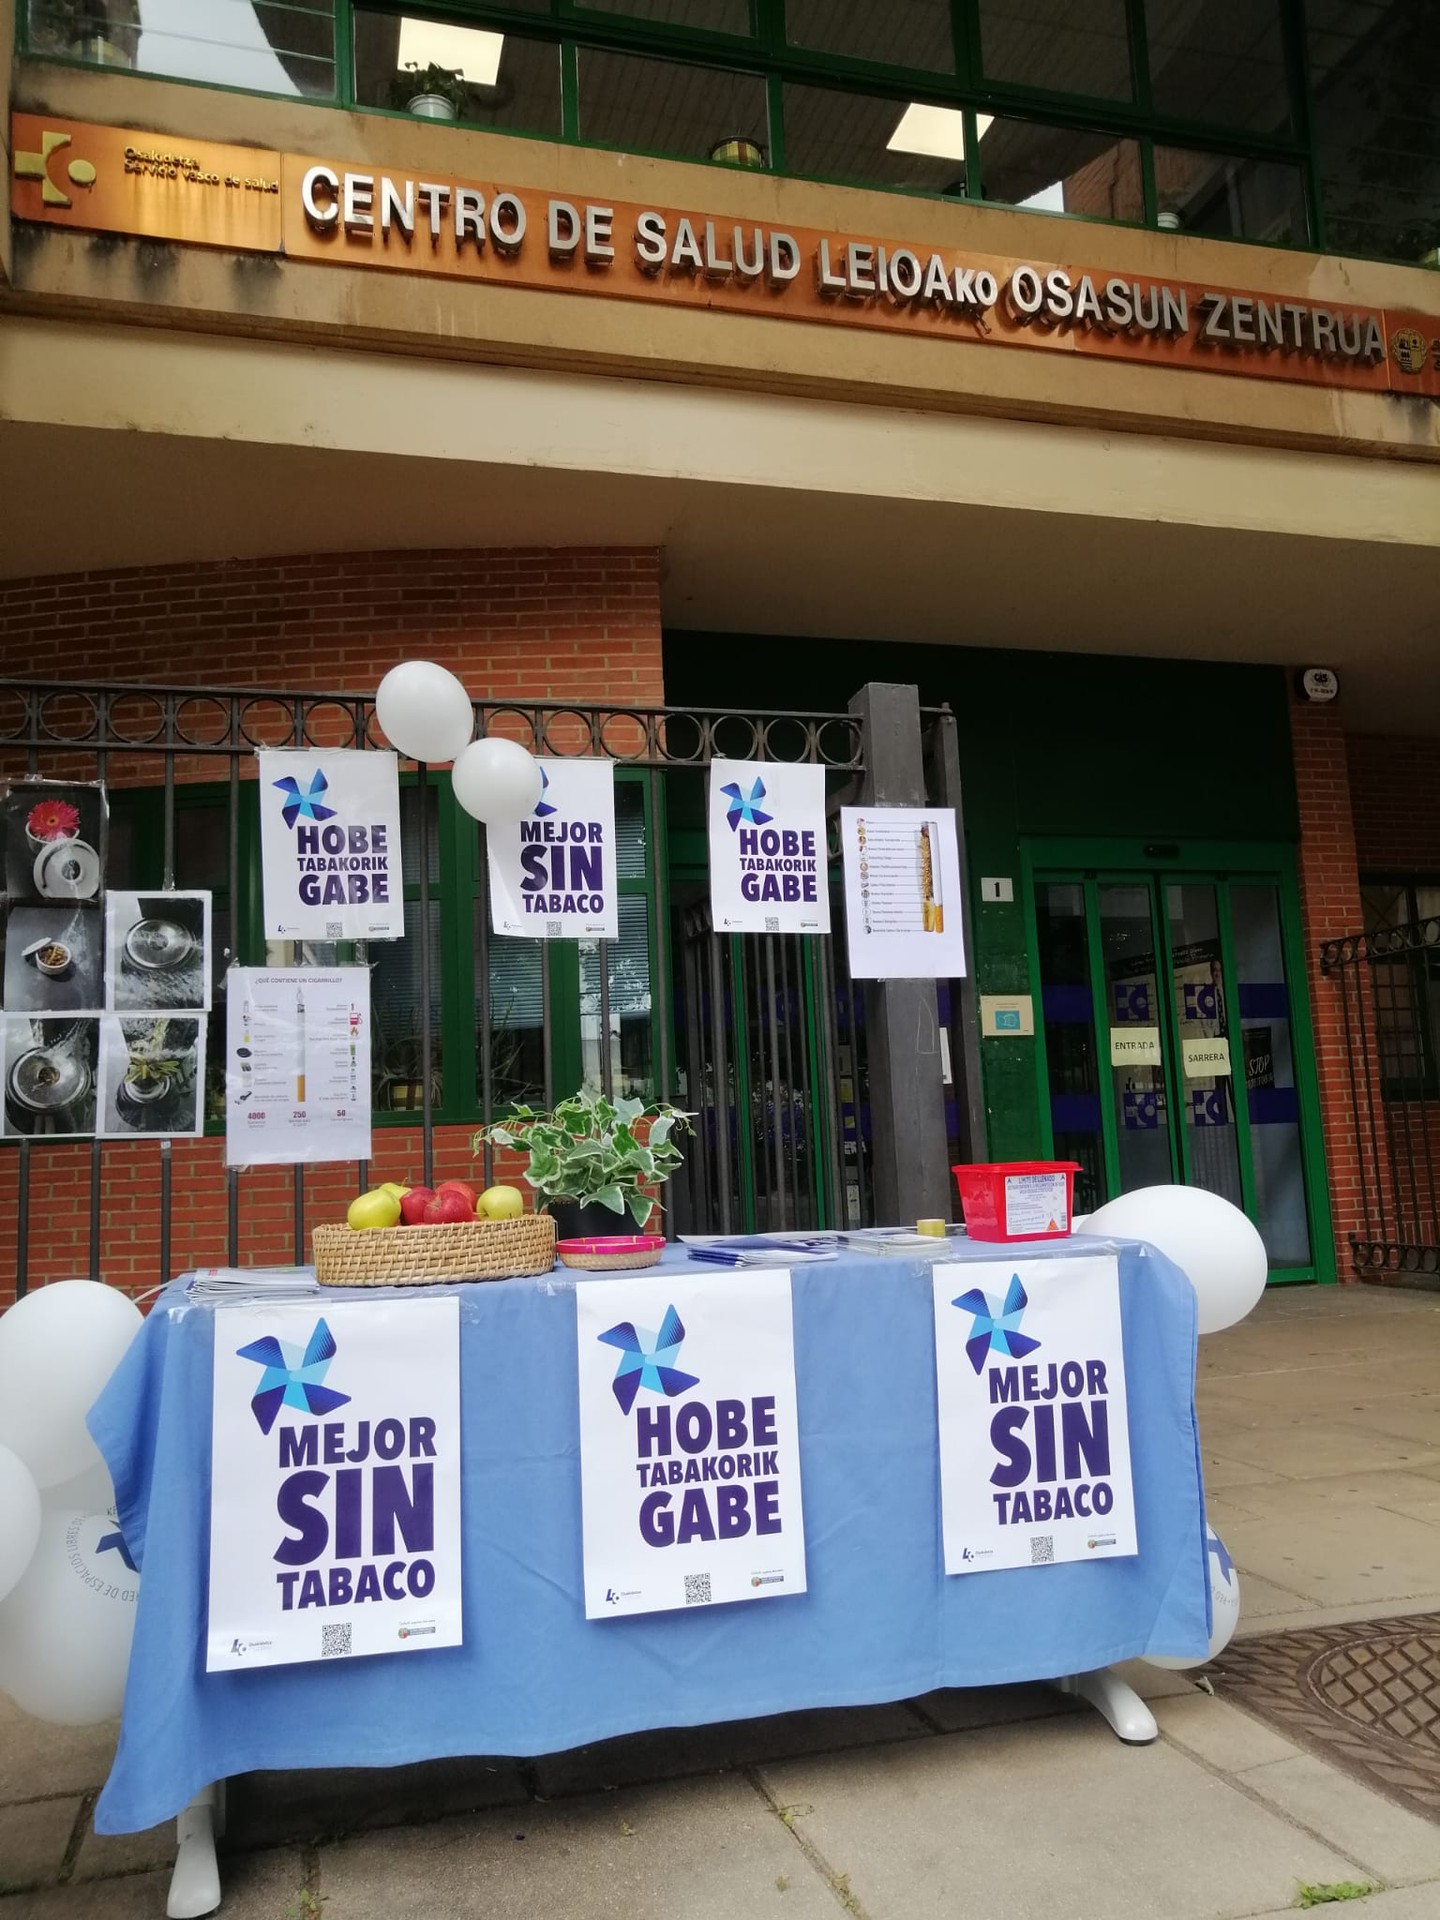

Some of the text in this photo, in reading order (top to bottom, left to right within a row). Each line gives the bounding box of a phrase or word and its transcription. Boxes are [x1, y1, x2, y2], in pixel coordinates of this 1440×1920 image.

[124, 158, 279, 193] Servicio vasco de salud
[302, 165, 527, 254] CENTRO
[547, 199, 614, 263] DE
[635, 210, 800, 284] SALUD
[1011, 265, 1189, 333] OSASUN
[1203, 293, 1387, 358] ZENTRUA
[297, 824, 389, 856] HOBE
[520, 821, 603, 844] MEJOR
[739, 829, 816, 857] HOBE
[297, 856, 389, 872] TABAKORIK
[519, 845, 602, 892] SIN
[739, 857, 817, 873] TABAKORIK
[298, 873, 390, 906] GABE
[522, 893, 605, 914] TABACO
[741, 873, 818, 902] GABE
[994, 881, 1001, 897] 1
[1115, 1040, 1155, 1051] ENTRADA
[1187, 1052, 1225, 1064] SARRERA
[248, 1112, 266, 1120] 4000
[336, 1109, 346, 1117] 50
[988, 1360, 1109, 1404] MEJOR
[279, 1416, 437, 1468] MEJOR
[637, 1396, 778, 1458] HOBE
[989, 1400, 1111, 1488] SIN
[636, 1451, 780, 1488] TABAKORIK
[273, 1462, 434, 1566] SIN
[639, 1480, 782, 1548] GABE
[993, 1482, 1113, 1525] TABACO
[68, 1553, 105, 1592] ESPACIOS
[277, 1558, 436, 1611] TABACO
[103, 1584, 120, 1599] DE
